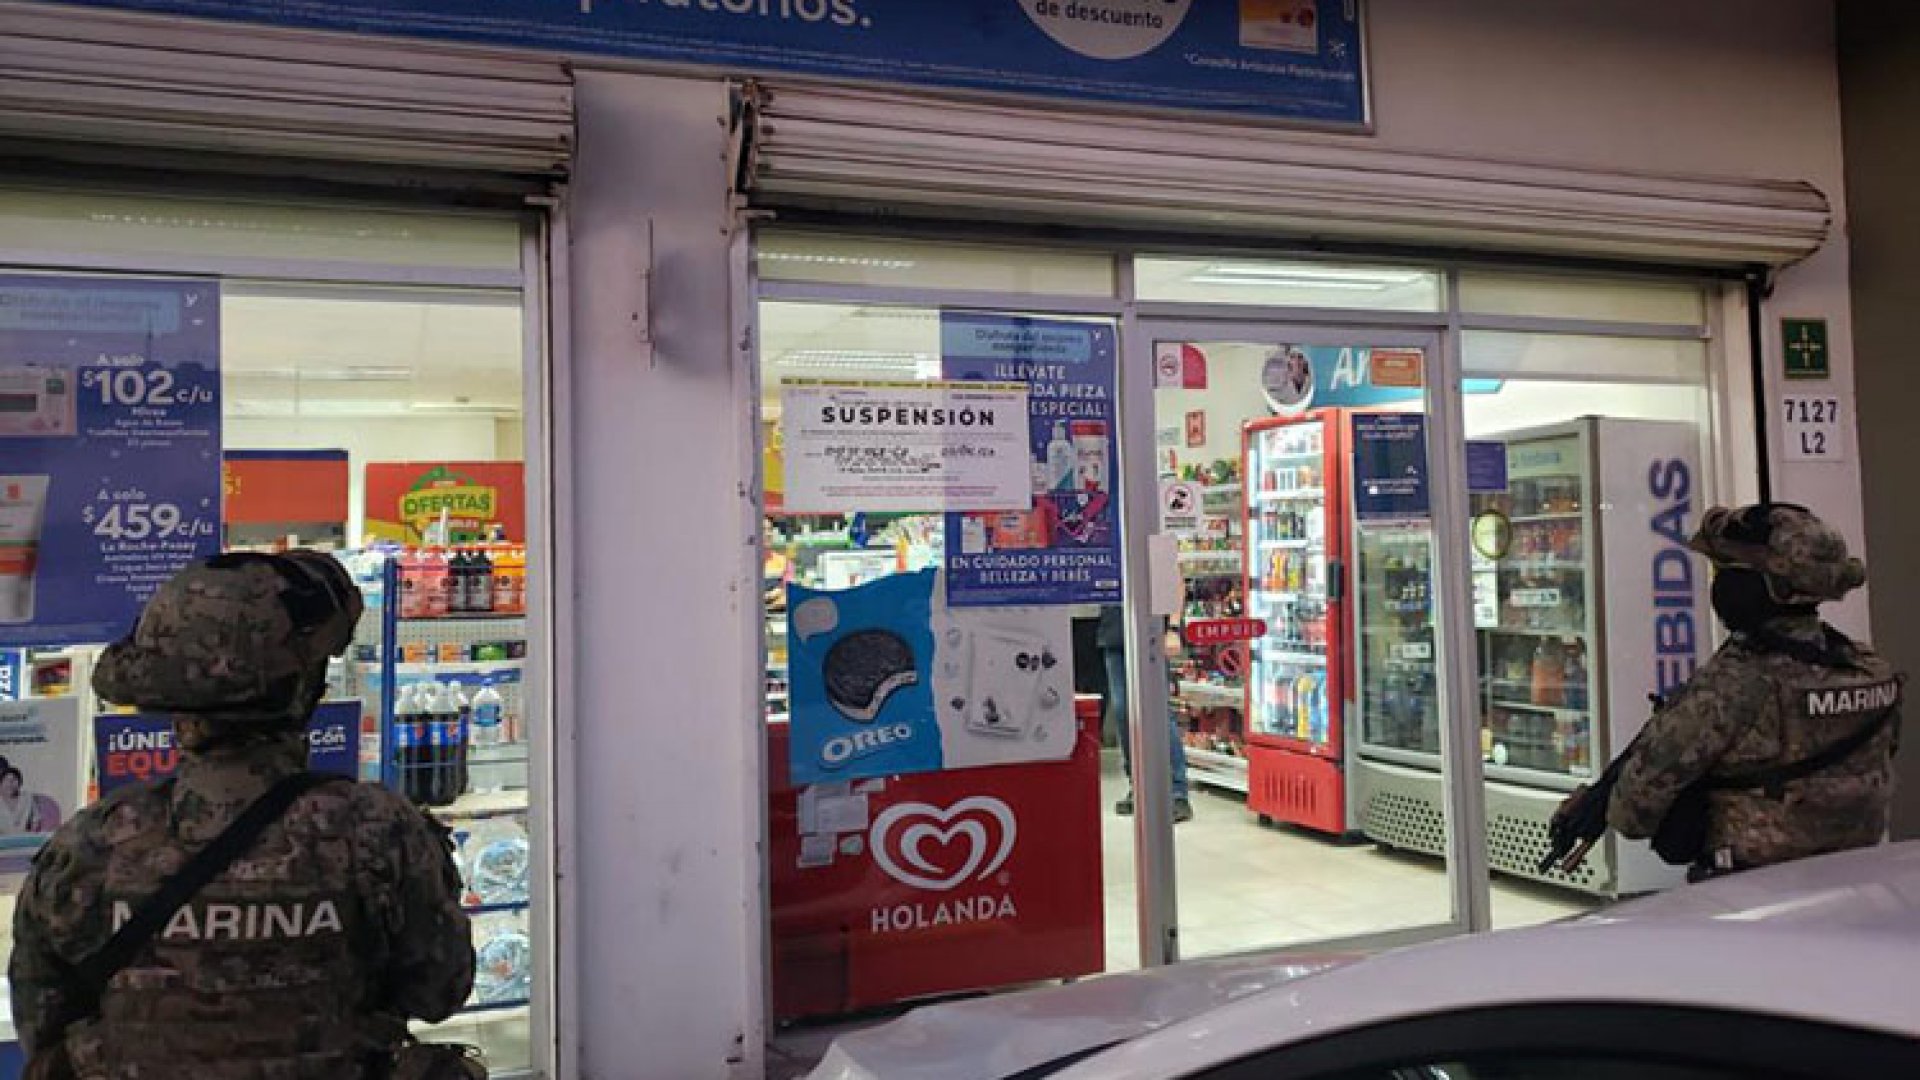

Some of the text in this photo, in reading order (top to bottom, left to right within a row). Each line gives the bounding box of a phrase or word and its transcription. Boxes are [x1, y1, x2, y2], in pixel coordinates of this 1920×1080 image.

[1036, 0, 1163, 29] de descuento
[1060, 383, 1107, 399] PIEZA
[821, 403, 995, 427] SUSPENSIÓN
[1783, 398, 1838, 423] 7127
[1801, 431, 1826, 454] L2
[403, 493, 491, 515] OFERTAS
[951, 553, 1113, 569] EN CUIDADO PERSONAL
[979, 570, 1038, 584] BELLEZA
[1650, 457, 1697, 698] EBIDAS
[1807, 682, 1898, 715] MARIN
[109, 727, 174, 752] ¡ÚNE
[821, 722, 912, 764] OREO
[107, 750, 178, 780] EQU
[871, 893, 1017, 934] HOLANDA
